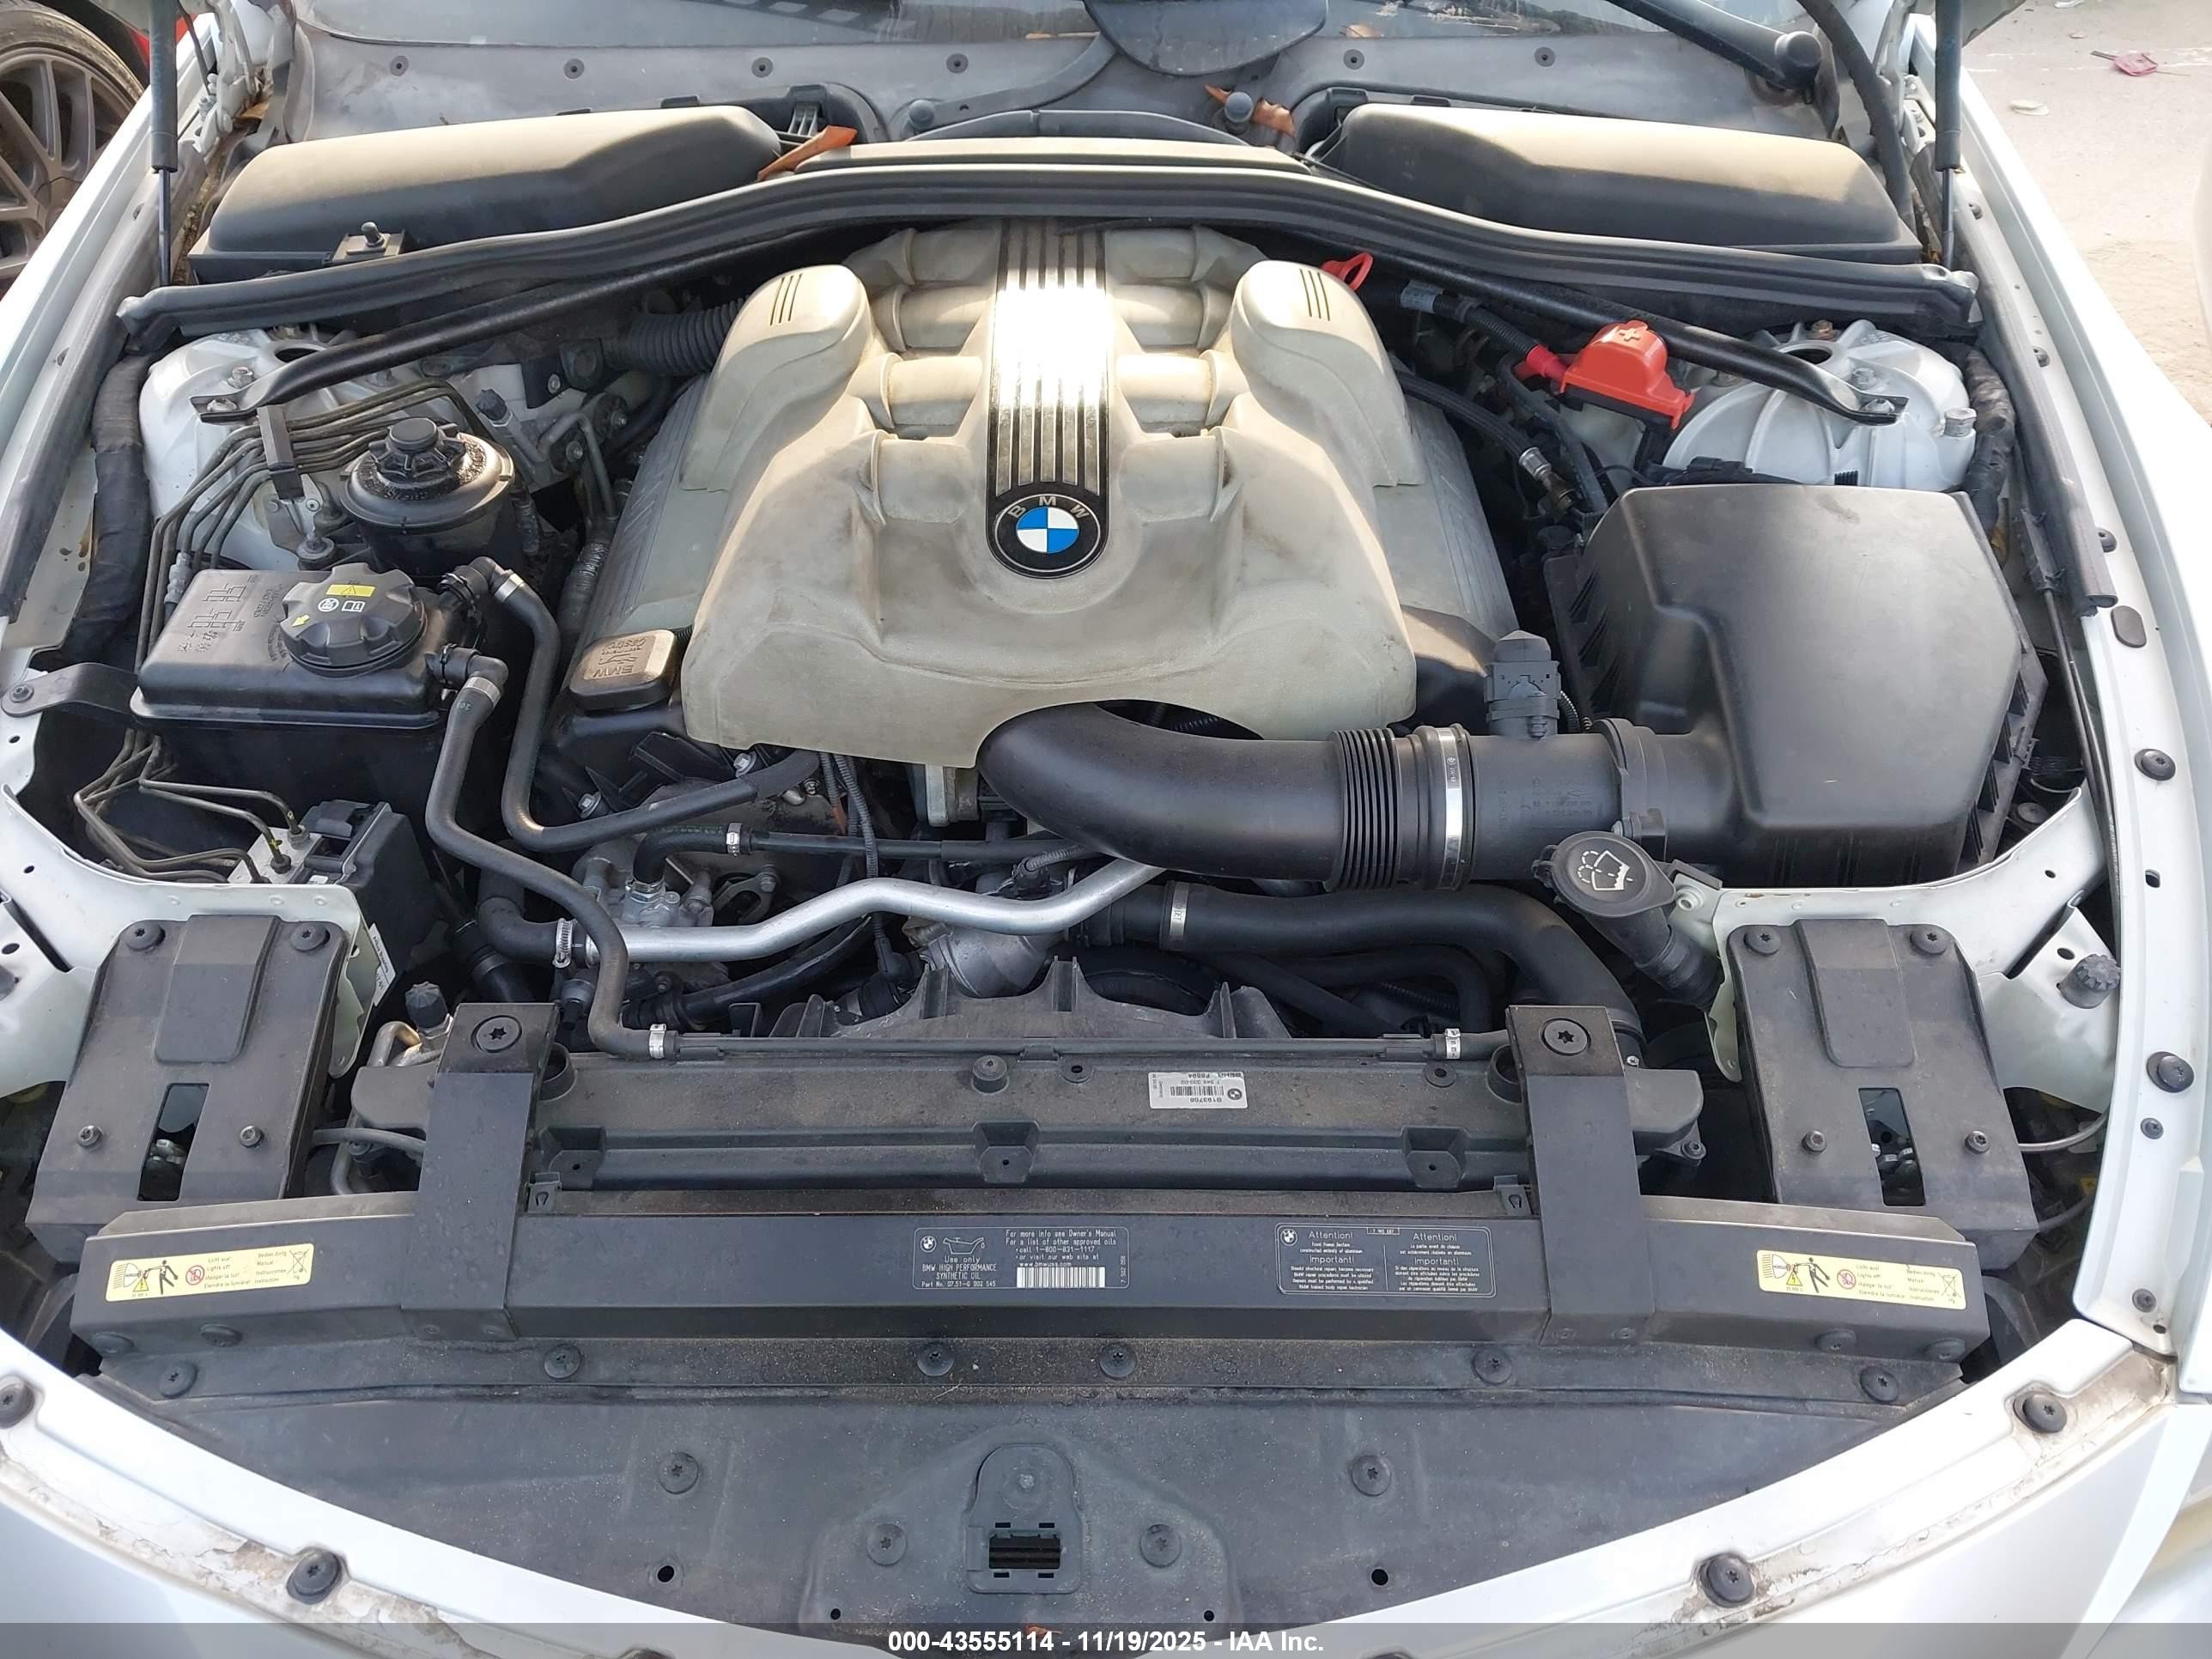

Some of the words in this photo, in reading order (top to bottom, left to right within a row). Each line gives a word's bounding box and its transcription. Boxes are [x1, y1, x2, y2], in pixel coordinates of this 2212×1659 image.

[1007, 496, 1090, 519] BMW
[1309, 1231, 1353, 1239] Attention!
[1413, 1233, 1457, 1242] Attention!
[1073, 1238, 1100, 1247] approved
[963, 1255, 980, 1264] only
[1310, 1255, 1354, 1264] Important!
[1414, 1257, 1459, 1266] Important!
